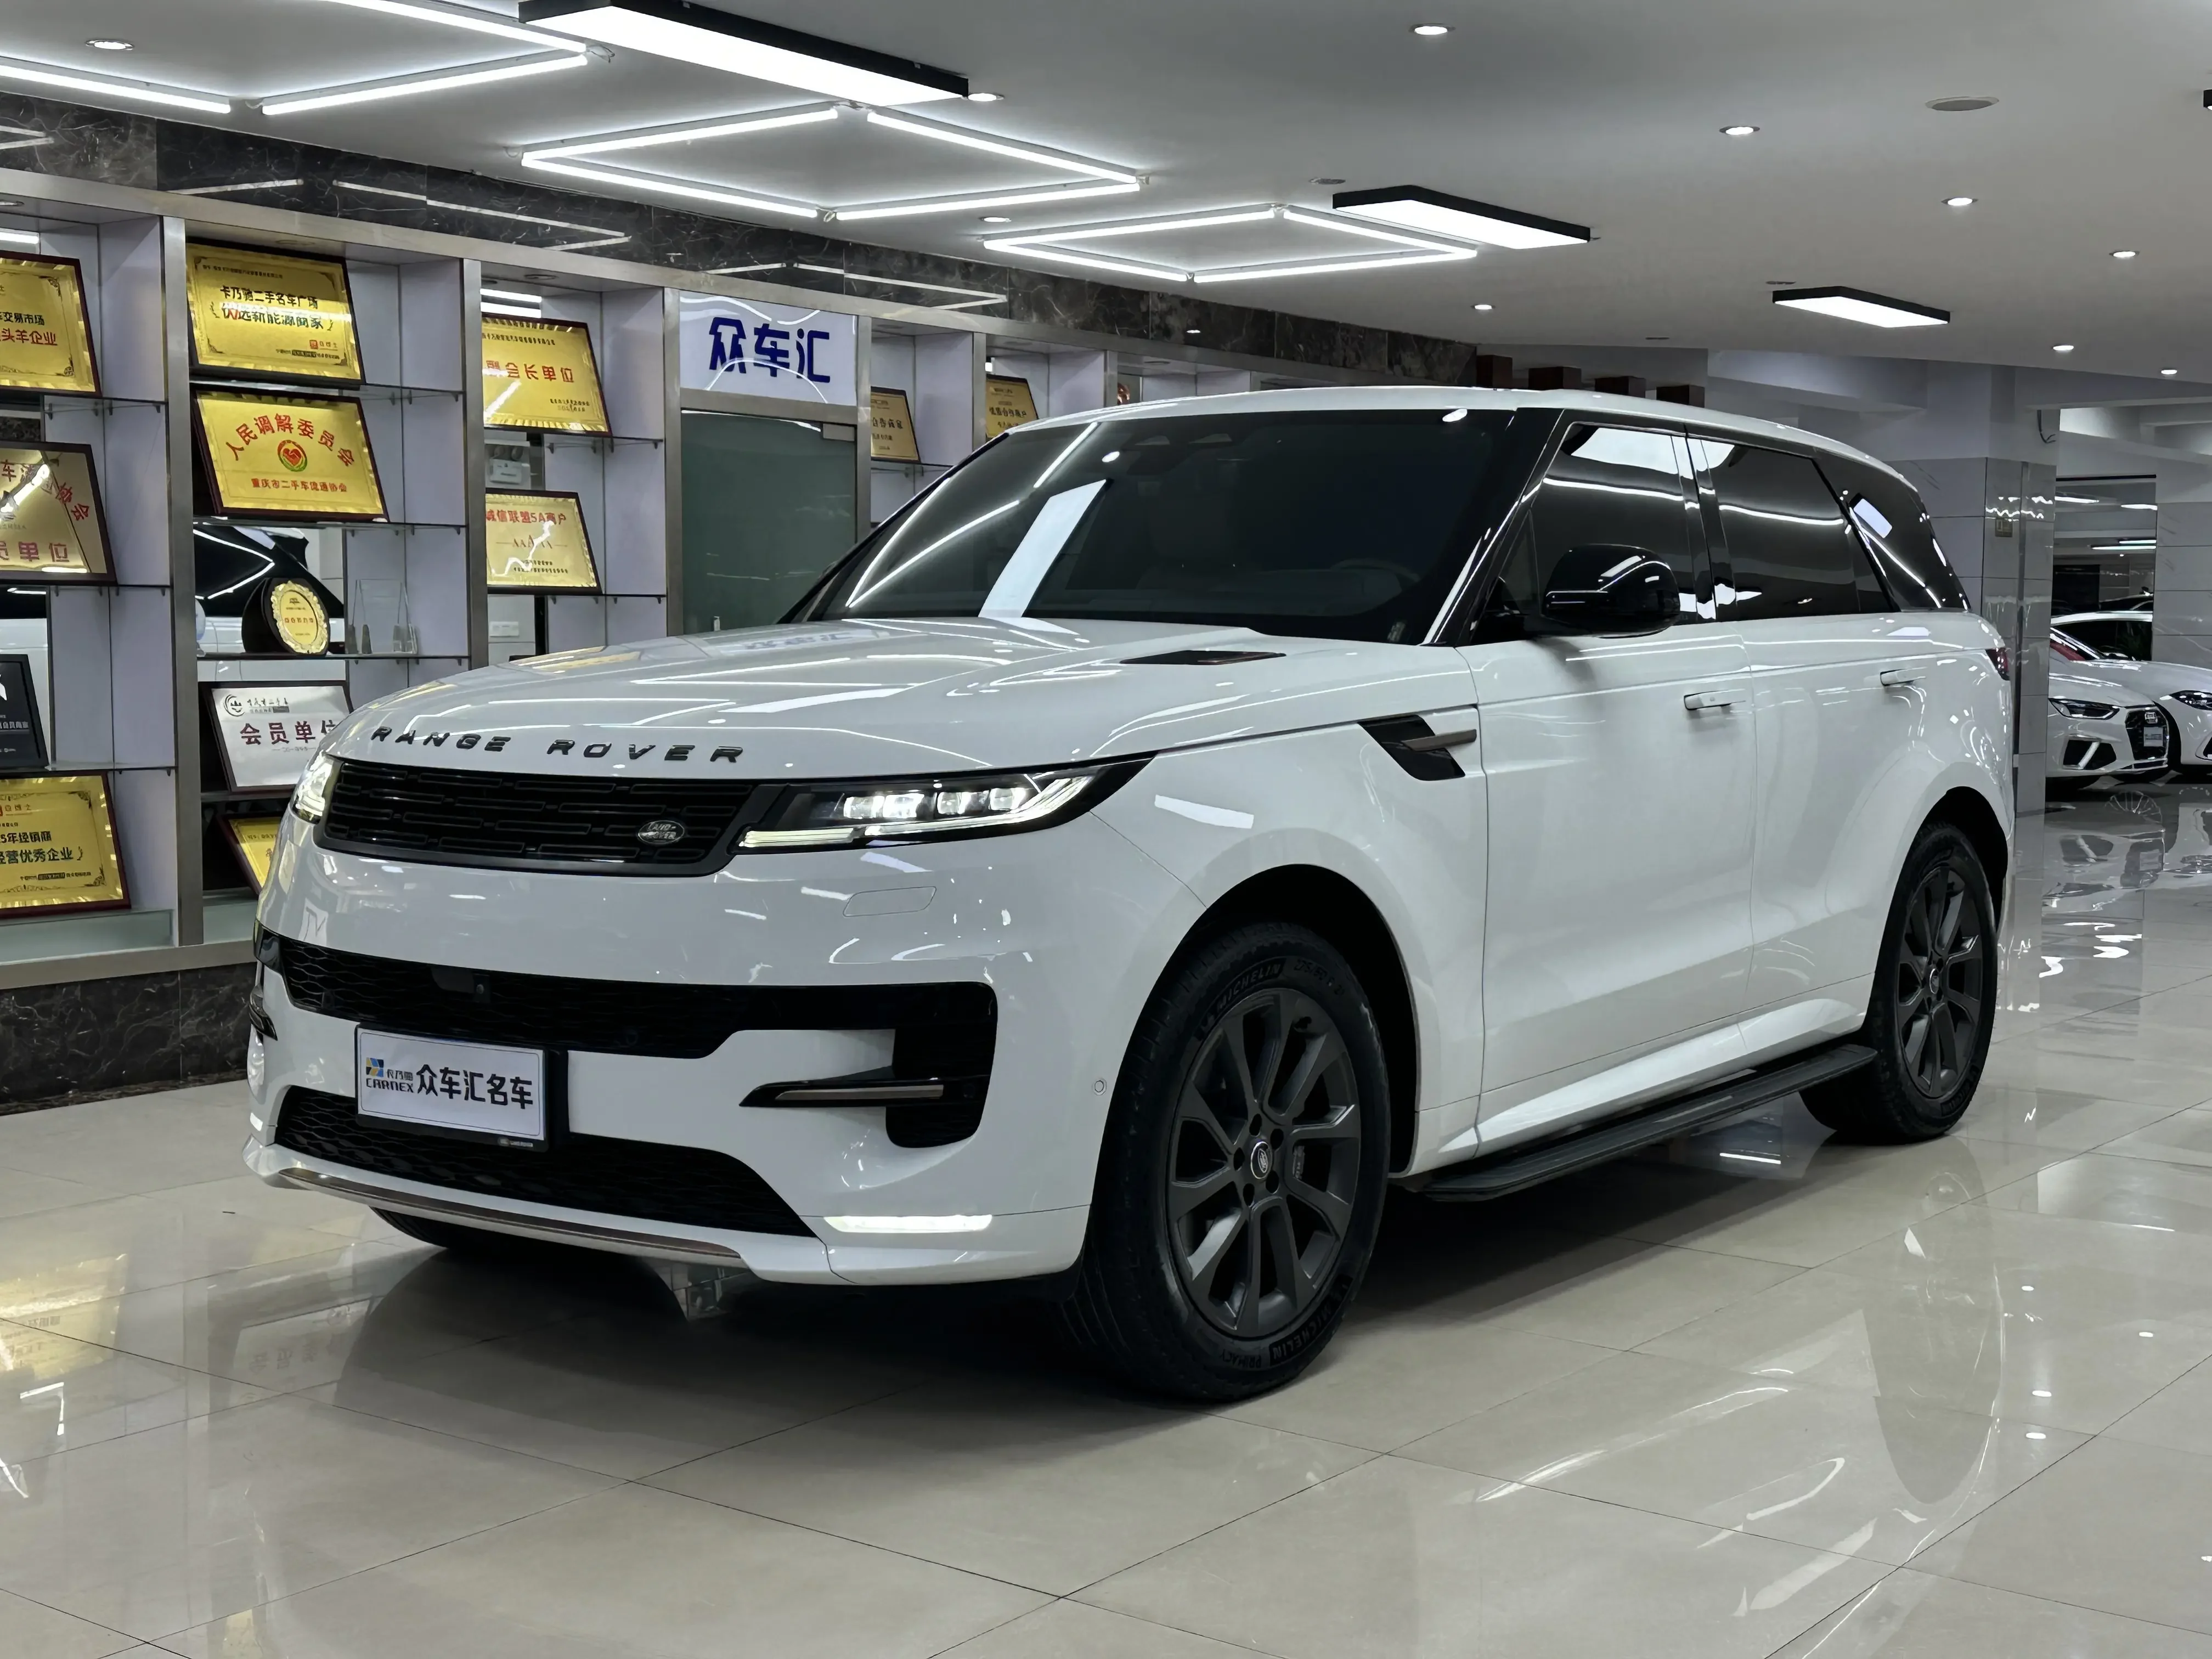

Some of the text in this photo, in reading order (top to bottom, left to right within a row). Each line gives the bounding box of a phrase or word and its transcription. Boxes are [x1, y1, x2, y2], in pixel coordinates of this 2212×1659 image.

[0, 312, 44, 325] 交易市场
[0, 328, 58, 346] 头羊企业
[709, 317, 831, 383] 众车汇
[225, 413, 355, 466] 人民调解委员会
[370, 726, 743, 763] RANGE ROVER
[1216, 963, 1282, 1013] MICHELIN
[366, 1077, 415, 1094] CARNEX
[416, 1064, 534, 1109] 众车汇名车
[1272, 1301, 1332, 1360] MICHELIN
